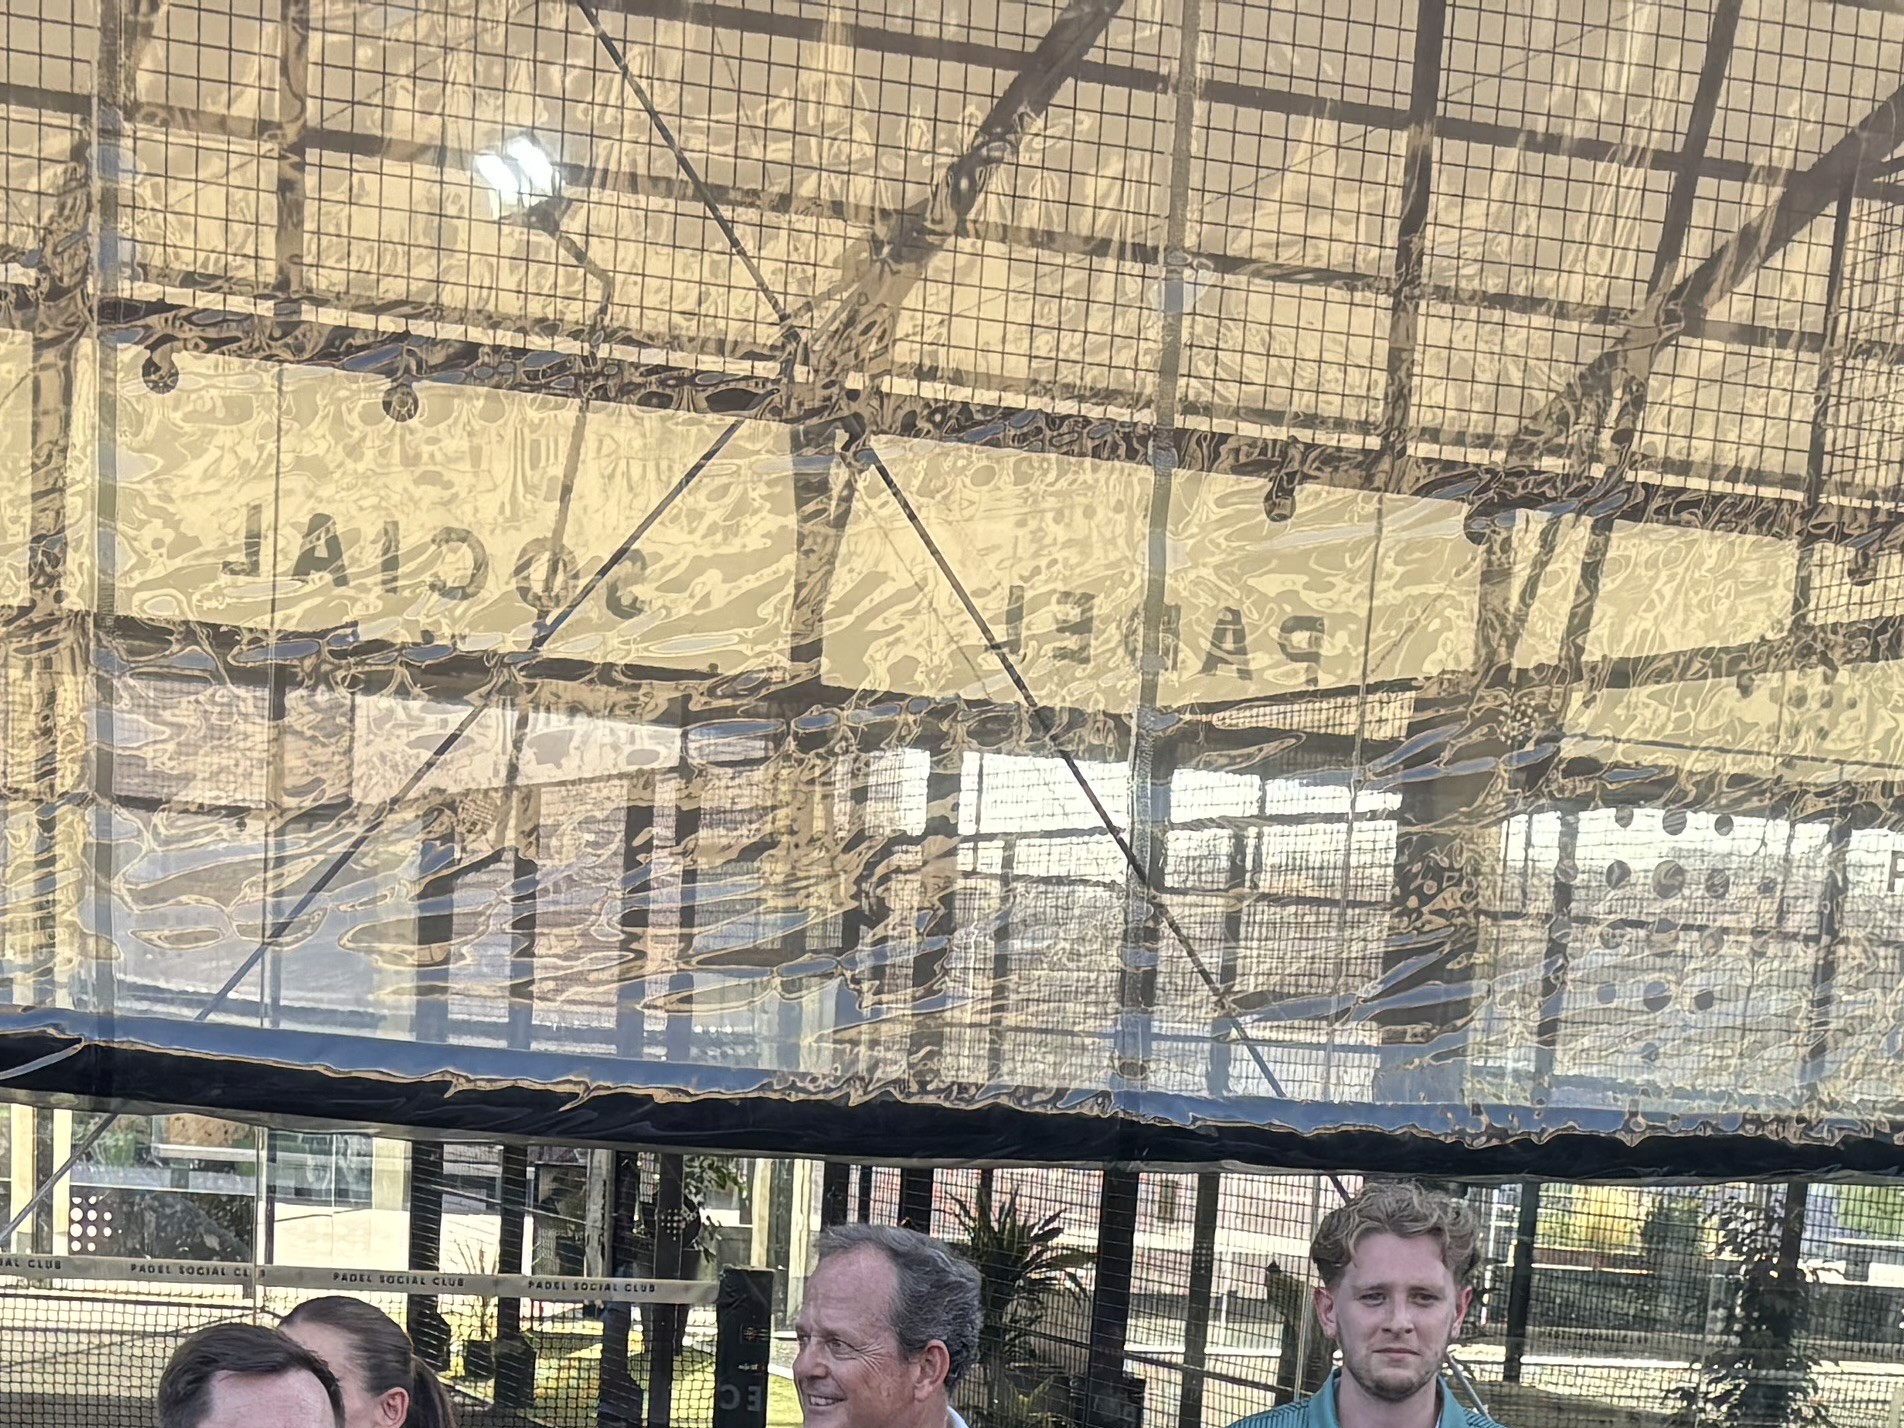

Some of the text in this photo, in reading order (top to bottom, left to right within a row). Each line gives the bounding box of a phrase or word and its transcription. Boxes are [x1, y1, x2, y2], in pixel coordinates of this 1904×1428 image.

[27, 1258, 62, 1270] CLUB
[130, 1263, 173, 1275] PADEL
[178, 1265, 227, 1277] SOCIAL
[332, 1272, 466, 1288] PADEL SOCIAL CLUB
[527, 1280, 656, 1294] PADEL SOCIAL CLUB
